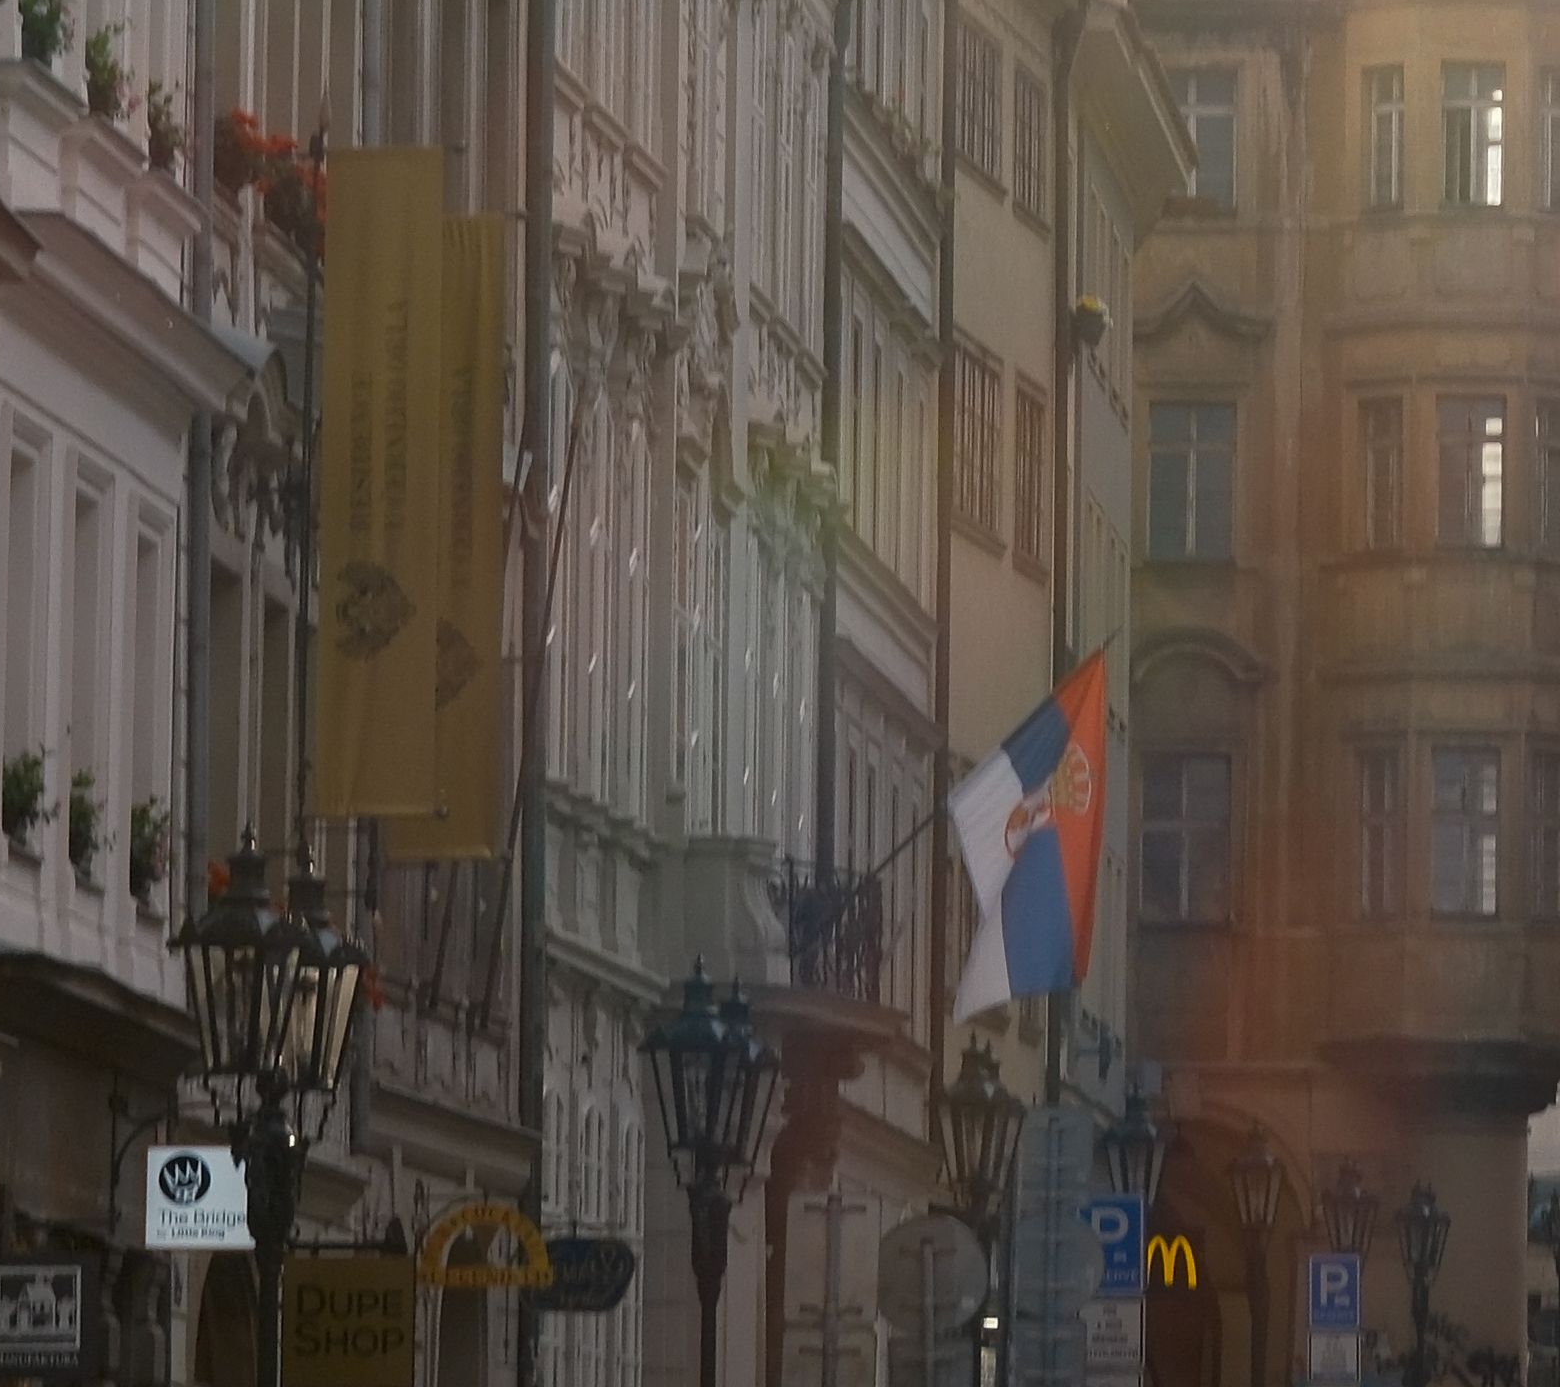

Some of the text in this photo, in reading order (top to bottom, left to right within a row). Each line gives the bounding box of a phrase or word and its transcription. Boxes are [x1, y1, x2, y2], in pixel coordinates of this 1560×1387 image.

[161, 1208, 246, 1228] The Bridge
[297, 1284, 404, 1321] DUPE
[1320, 1263, 1348, 1306] P
[294, 1323, 404, 1358] SHOP
